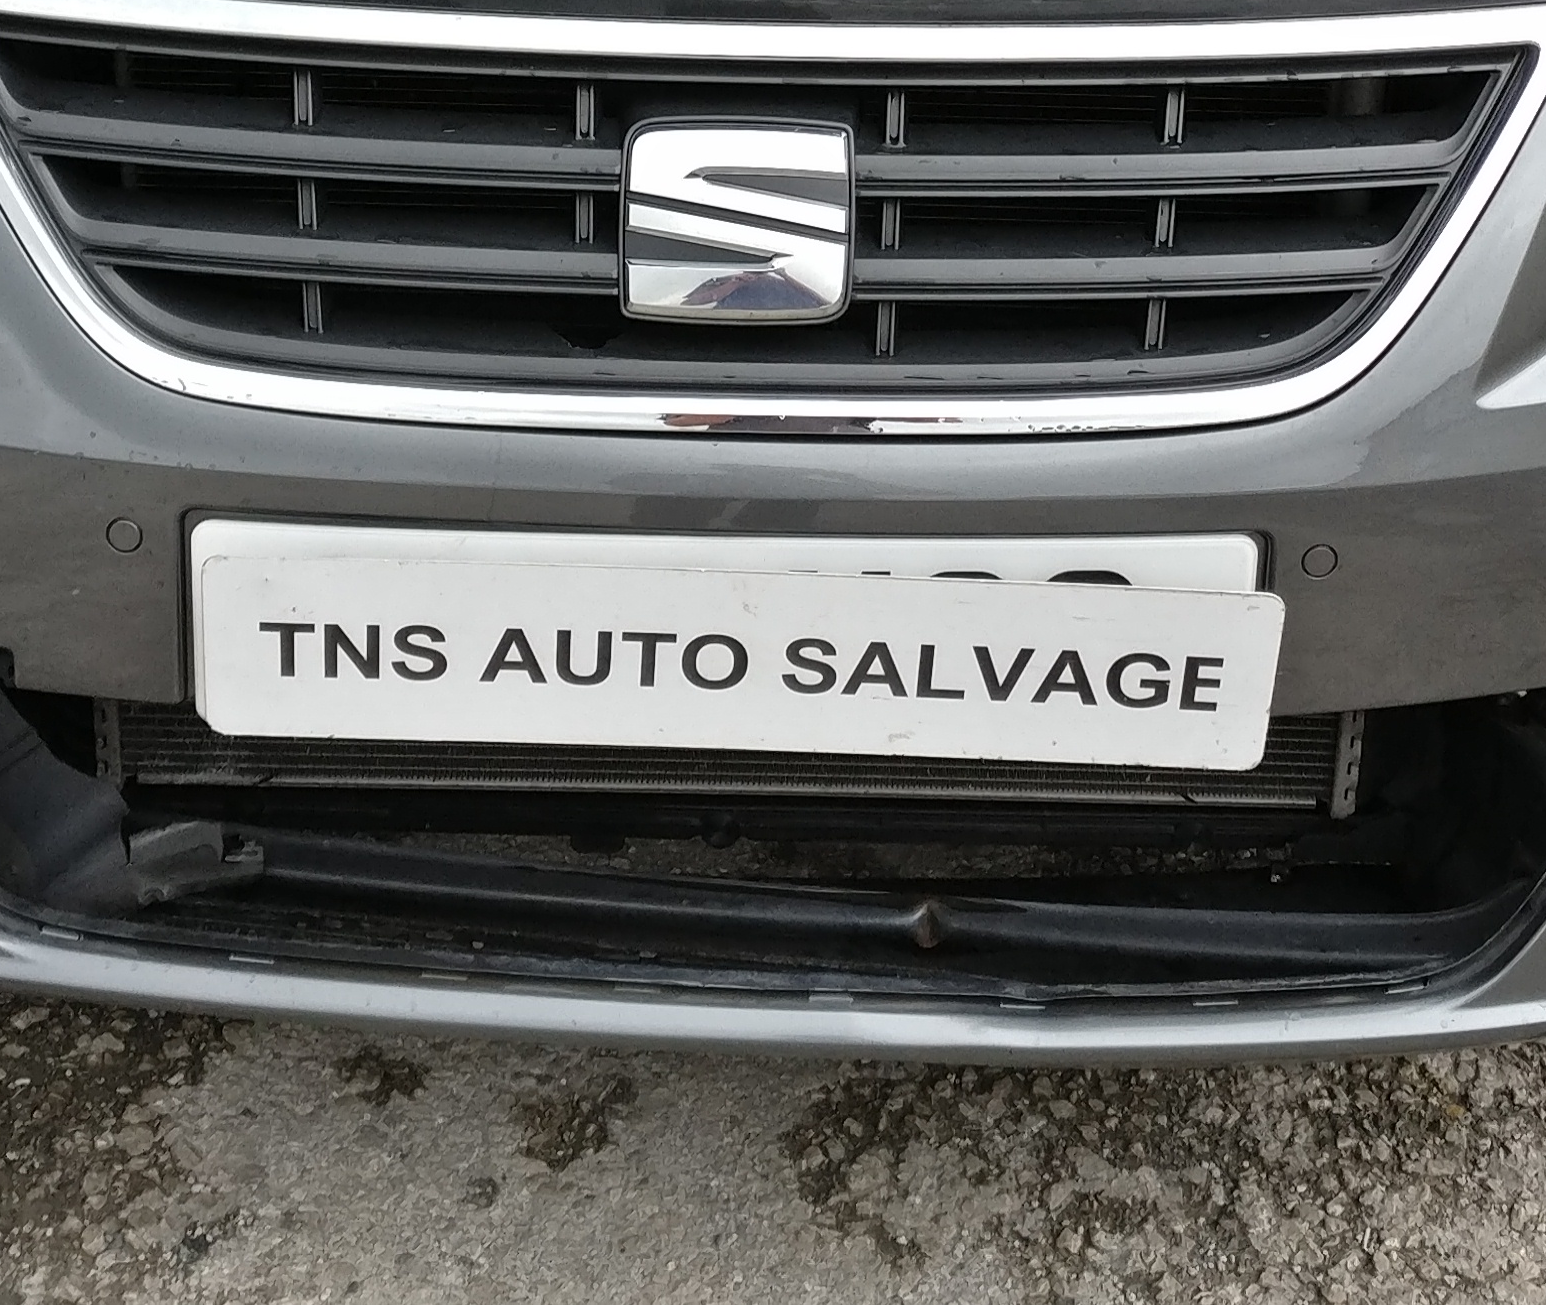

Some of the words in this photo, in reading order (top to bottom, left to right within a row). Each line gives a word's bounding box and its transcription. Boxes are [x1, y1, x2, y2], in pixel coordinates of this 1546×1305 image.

[259, 622, 448, 681] TNS
[479, 628, 749, 690] AUTO
[781, 637, 1225, 712] SALVAGE
